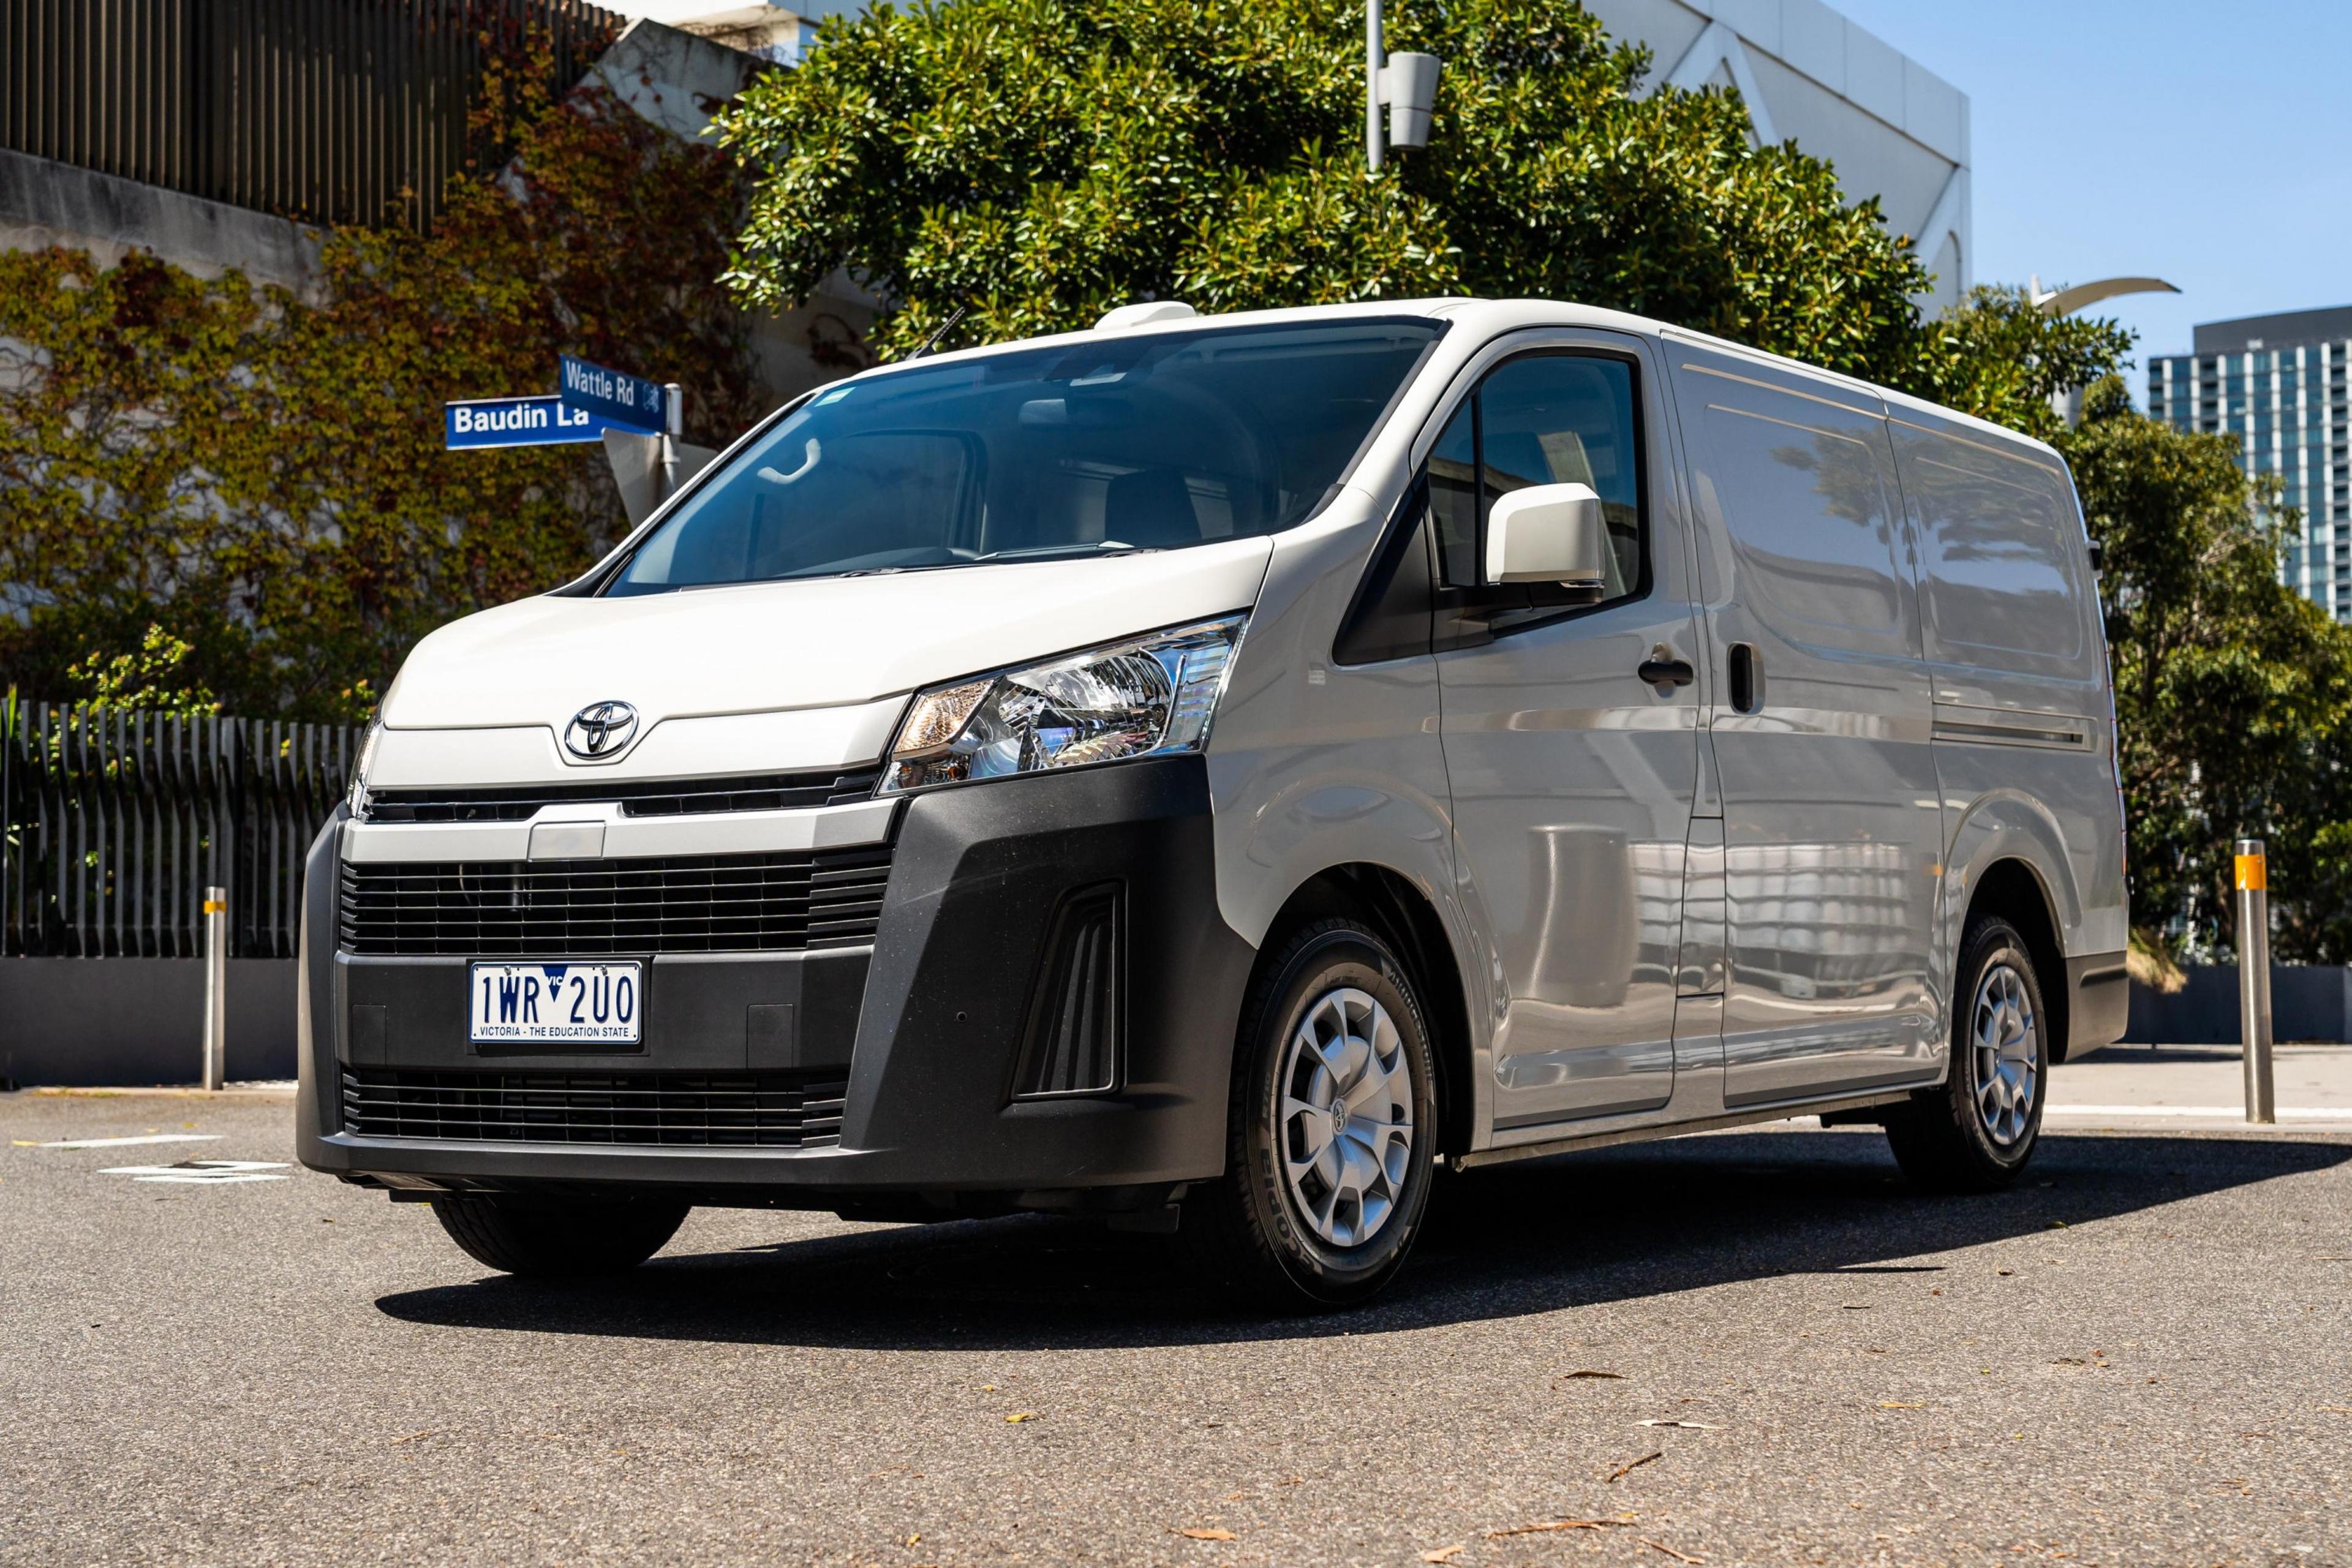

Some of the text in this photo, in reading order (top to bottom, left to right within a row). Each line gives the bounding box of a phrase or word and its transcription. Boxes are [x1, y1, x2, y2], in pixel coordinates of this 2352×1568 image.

[566, 360, 634, 406] Wattle Rd
[454, 402, 589, 433] Baudin La
[547, 976, 564, 987] VIC
[483, 976, 540, 1023] 1WR
[480, 1027, 520, 1036] VICTORIA
[530, 1027, 546, 1036] THE
[549, 1027, 599, 1037] EDUCATION
[603, 1027, 629, 1037] STATE
